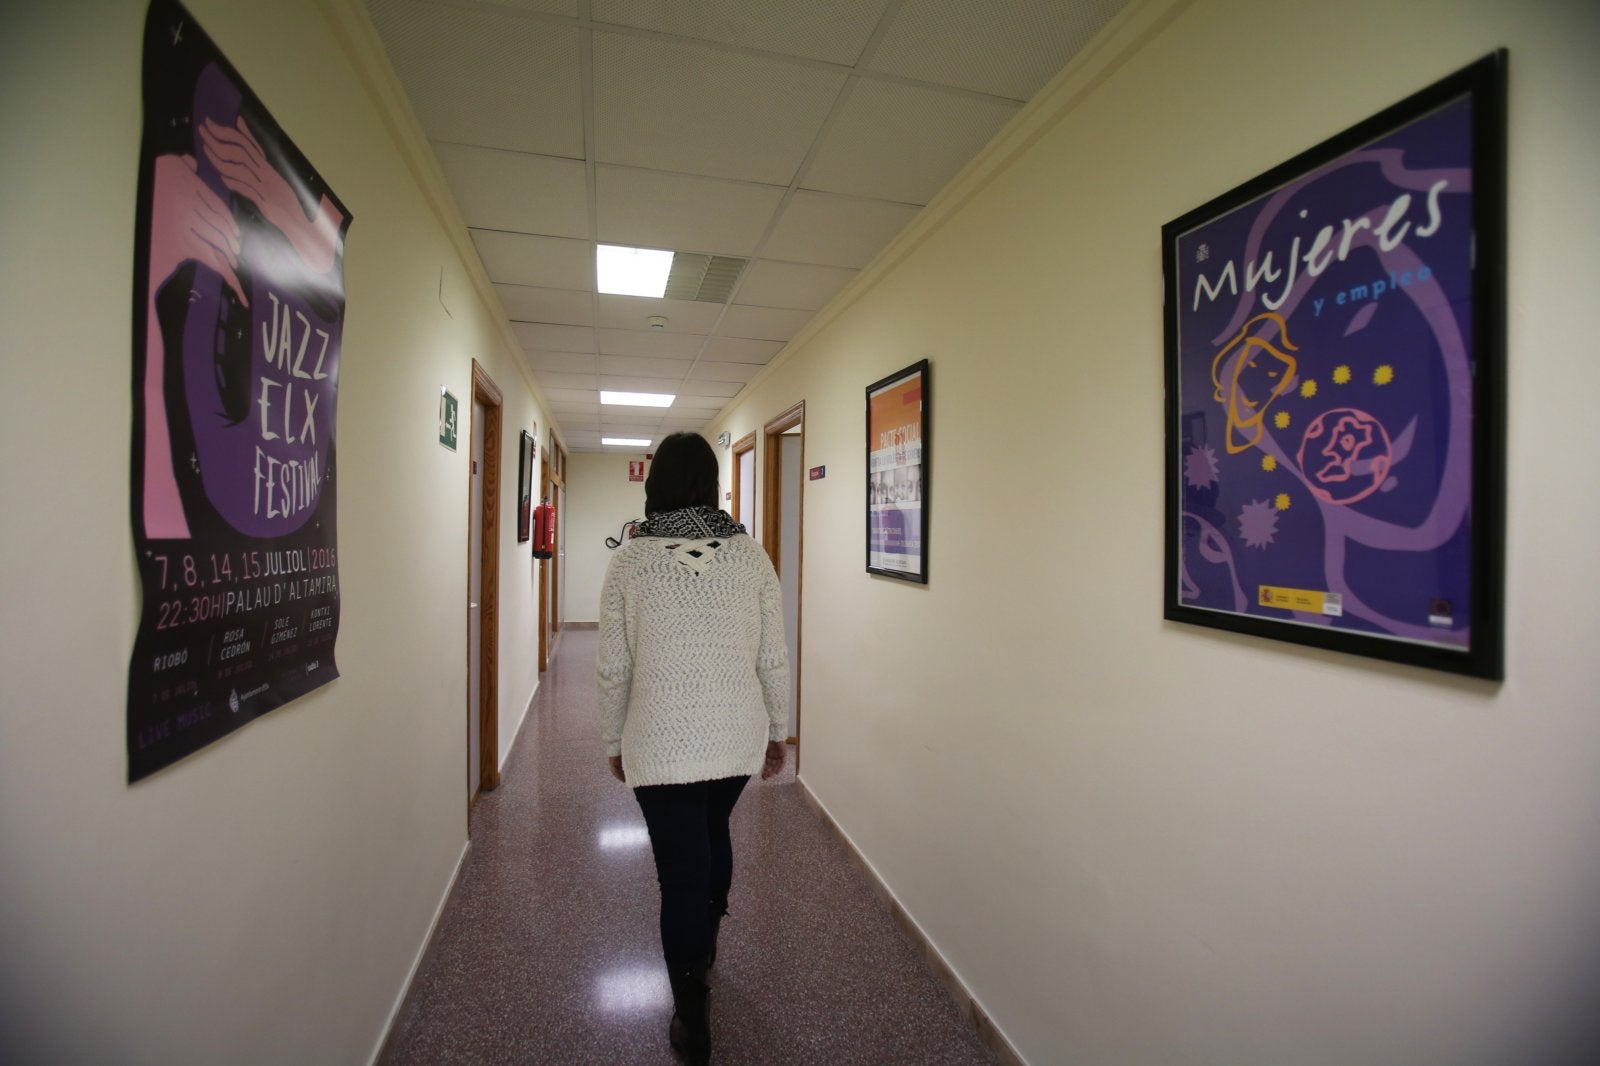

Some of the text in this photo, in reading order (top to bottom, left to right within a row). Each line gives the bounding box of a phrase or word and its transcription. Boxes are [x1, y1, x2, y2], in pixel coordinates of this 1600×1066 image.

[1193, 180, 1448, 312] Mujeres
[1312, 265, 1432, 317] y empleo
[262, 291, 330, 381] JAZZ
[257, 376, 319, 446] ELX
[254, 445, 322, 519] FESTIVAL
